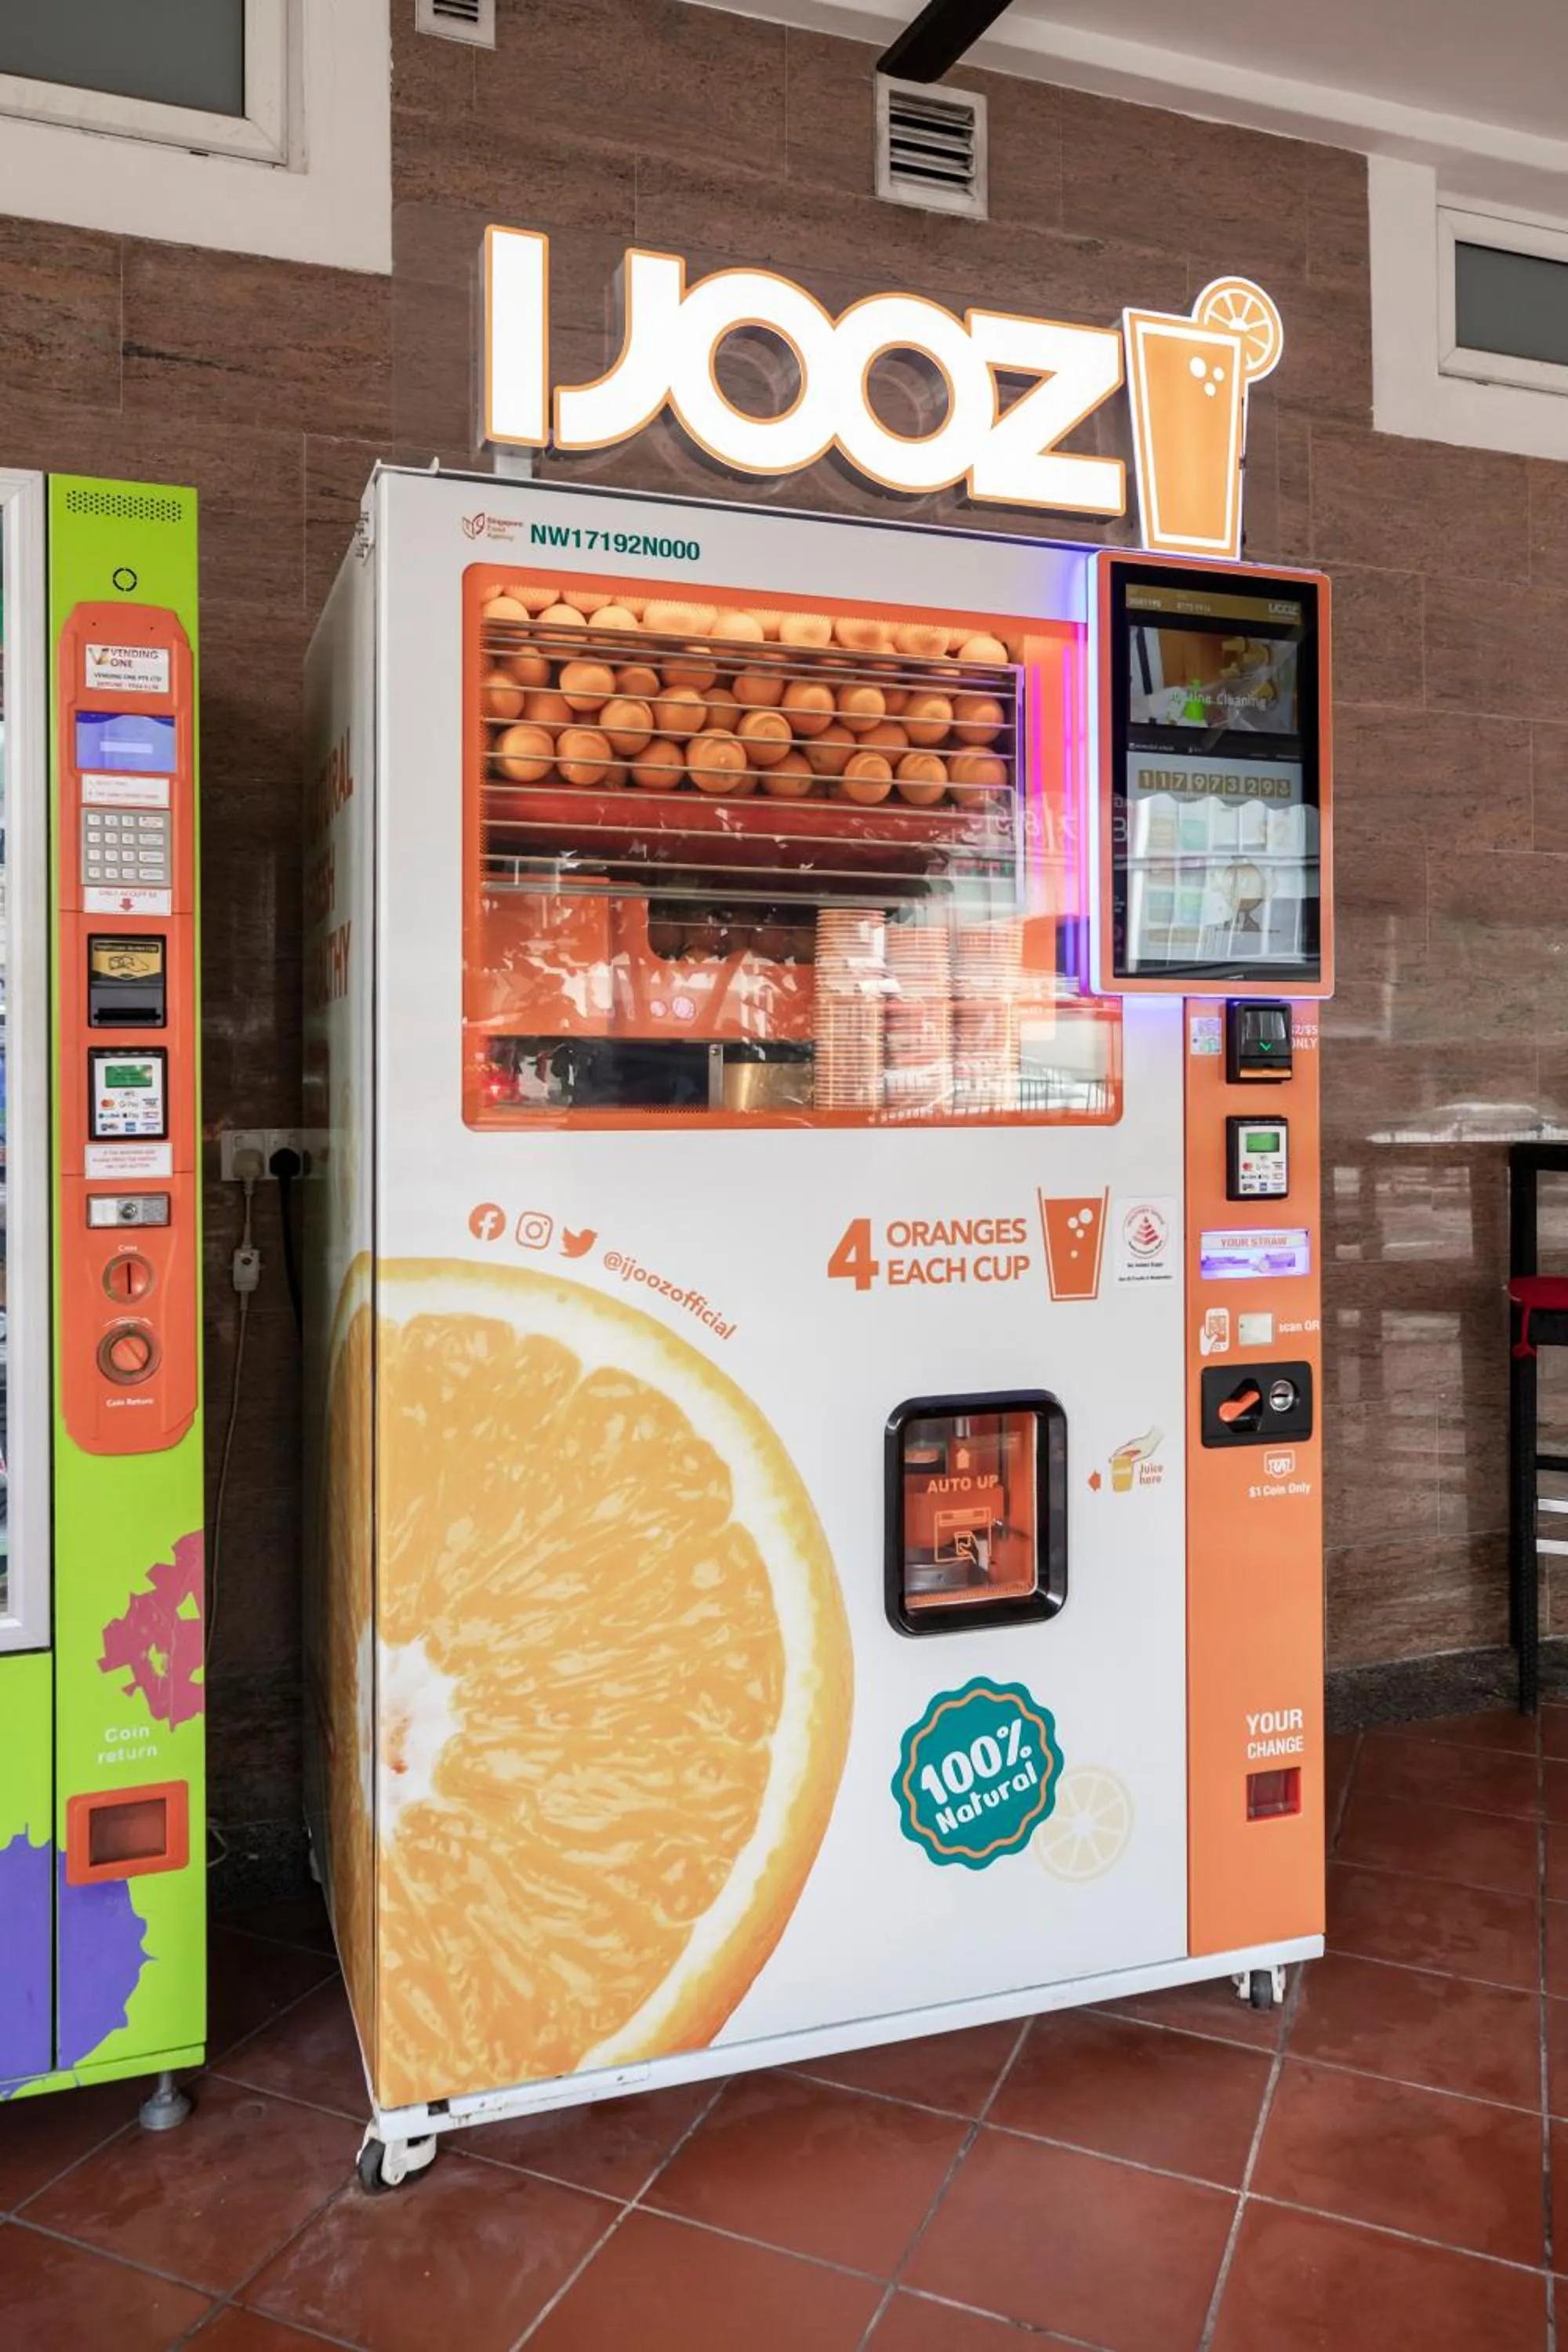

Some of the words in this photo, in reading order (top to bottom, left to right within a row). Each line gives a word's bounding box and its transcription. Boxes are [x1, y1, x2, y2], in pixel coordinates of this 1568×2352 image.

[485, 223, 1124, 516] IJOOZ
[531, 524, 701, 561] NW17192N000
[111, 648, 159, 659] VENDING
[111, 659, 133, 668] ONE
[887, 1218, 1027, 1247] ORANGES
[1221, 1237, 1249, 1248] YOUR
[1250, 1236, 1287, 1247] STRAW
[827, 1218, 879, 1290] 4
[887, 1258, 967, 1286] EACH
[973, 1255, 1031, 1282] CUP
[603, 1251, 739, 1341] @ijoozofficial
[1279, 1321, 1302, 1332] scan
[1139, 1464, 1164, 1475] Juice
[1139, 1473, 1162, 1485] here
[927, 1476, 971, 1494] AUTO
[977, 1475, 1000, 1488] UP
[1262, 1483, 1287, 1496] Coin
[1288, 1481, 1312, 1494] Only
[1246, 1708, 1304, 1736] YOUR
[105, 1726, 150, 1744] Coin
[97, 1743, 158, 1766] return
[1247, 1735, 1305, 1760] CHANGE
[920, 1718, 1033, 1806] 100%
[935, 1761, 1038, 1835] Natural
